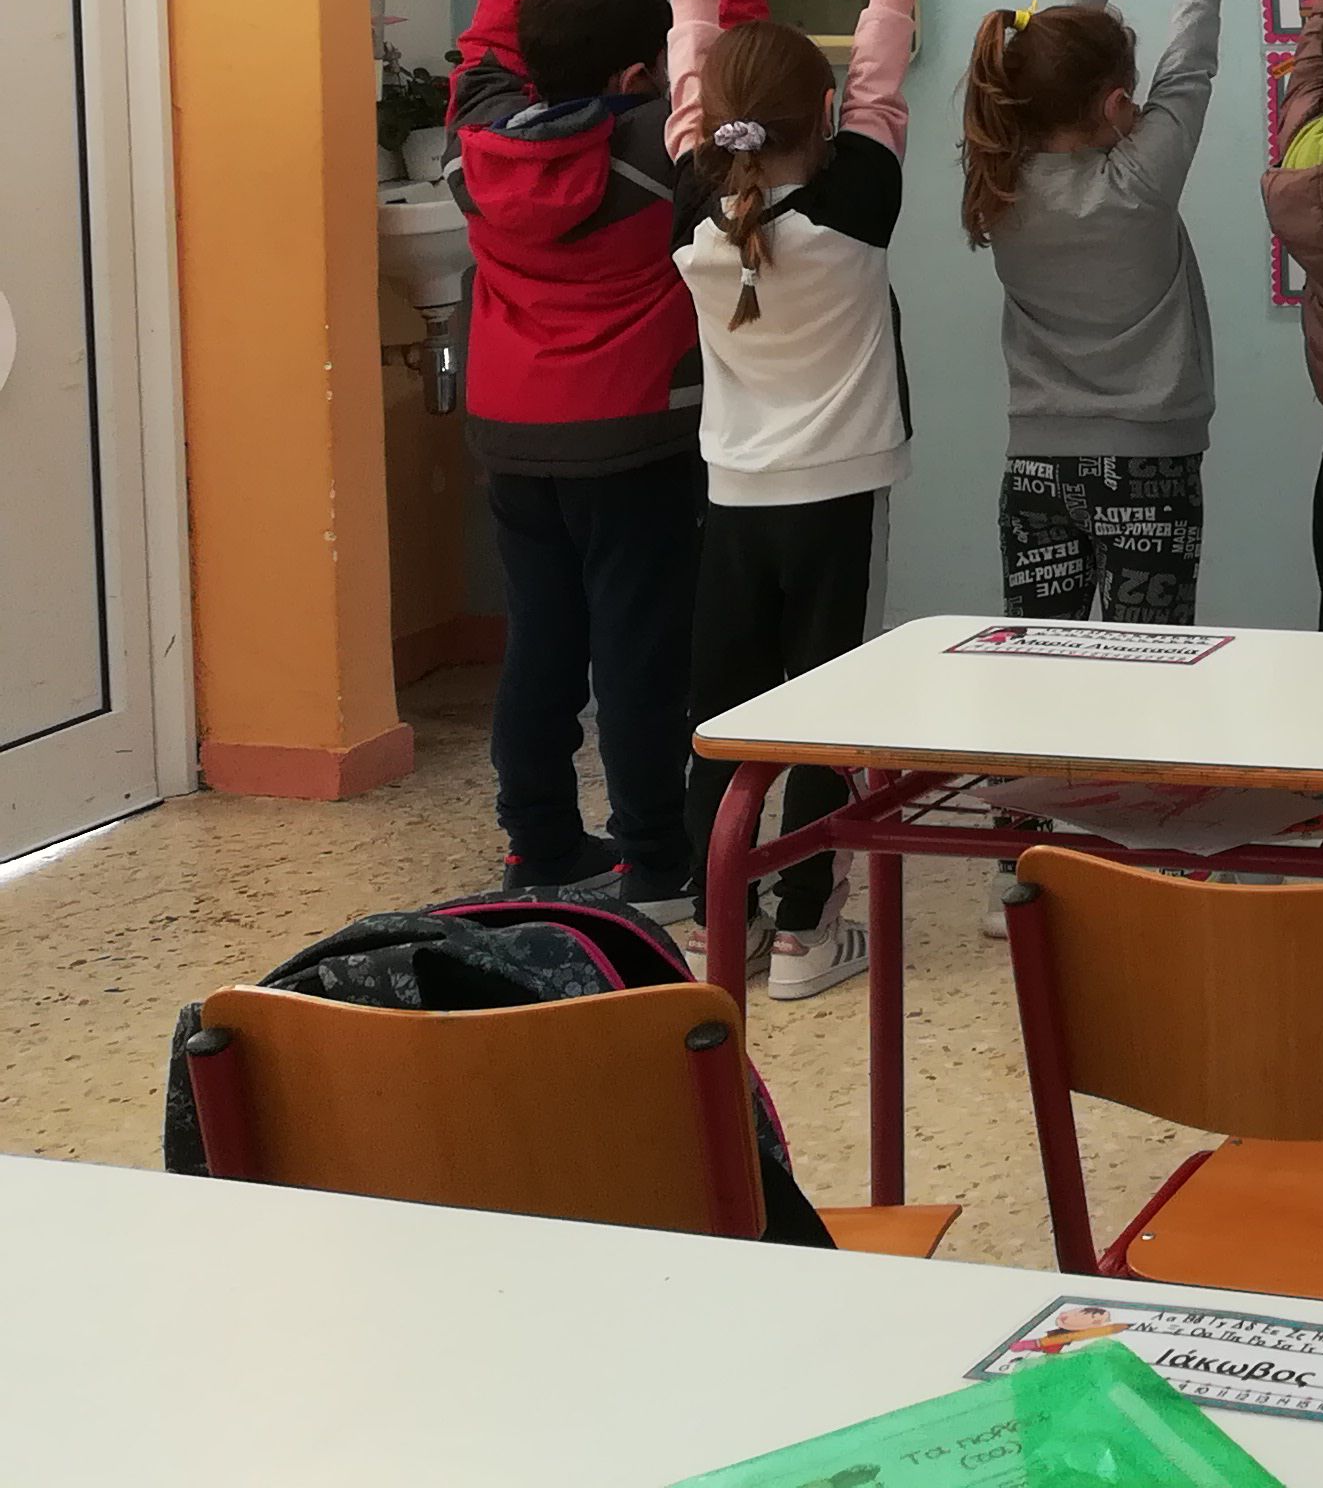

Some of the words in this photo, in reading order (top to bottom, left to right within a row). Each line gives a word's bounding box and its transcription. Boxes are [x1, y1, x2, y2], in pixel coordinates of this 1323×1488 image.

[1094, 506, 1156, 522] READY
[1016, 539, 1080, 567] READY
[1114, 536, 1162, 553] LOVE
[1036, 574, 1084, 598] LOVE
[1156, 1348, 1316, 1387] Ιάκωβος
